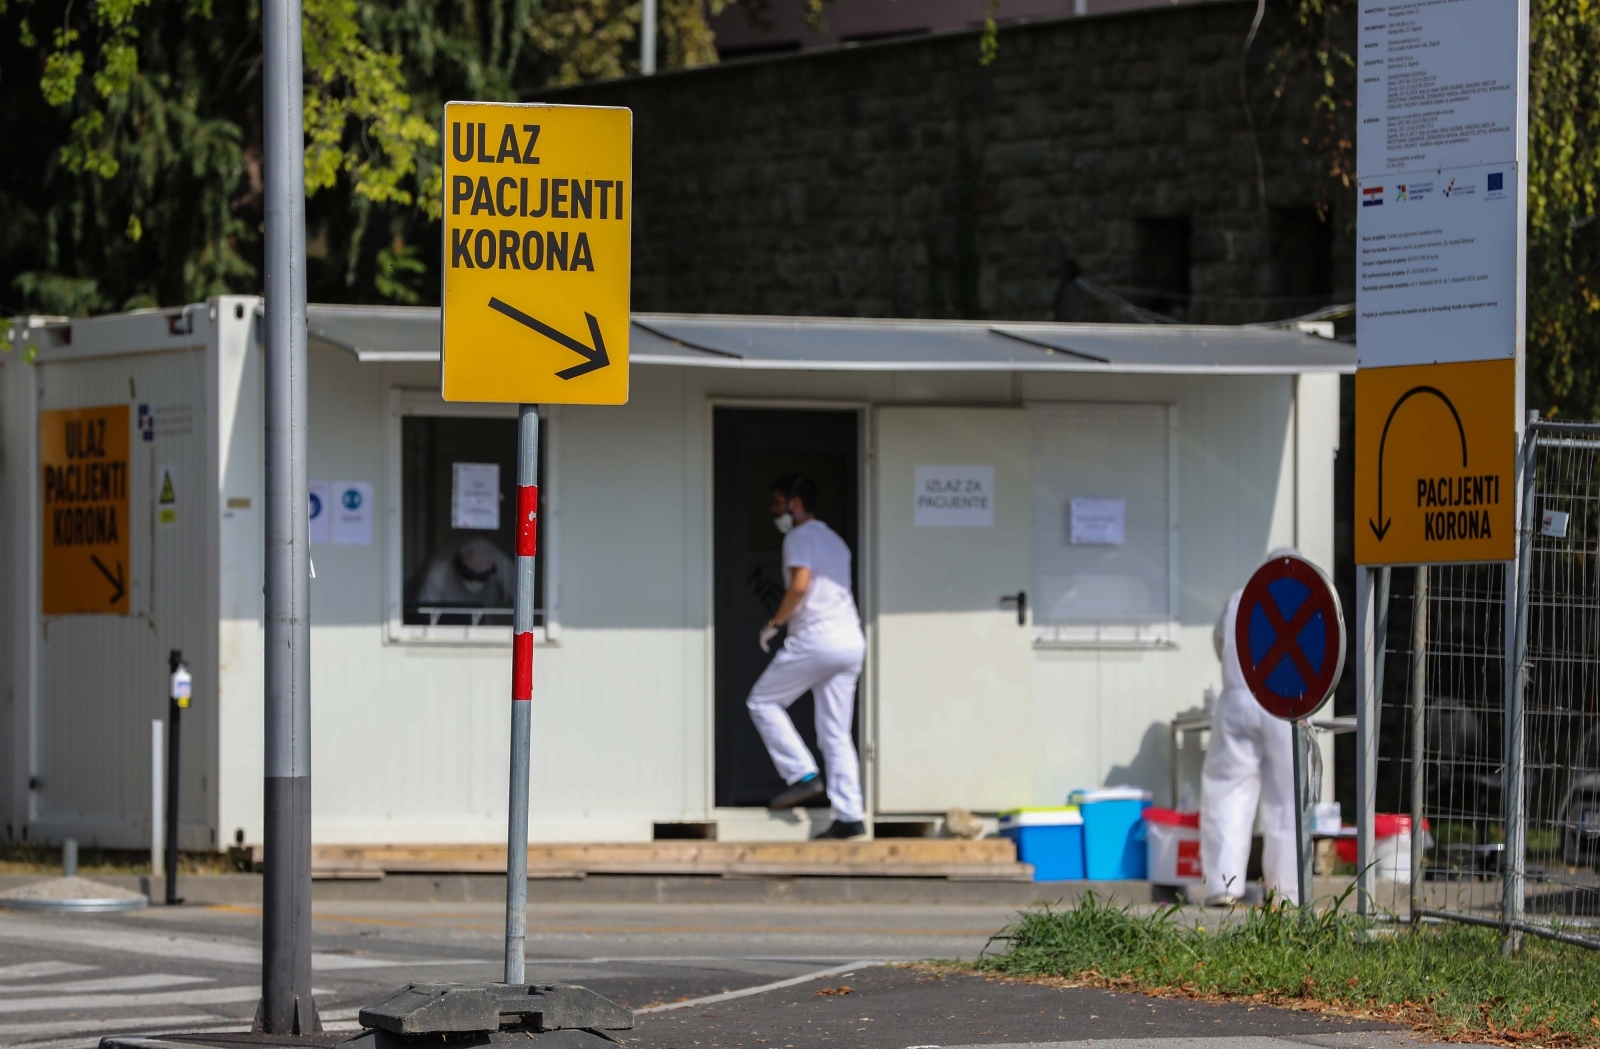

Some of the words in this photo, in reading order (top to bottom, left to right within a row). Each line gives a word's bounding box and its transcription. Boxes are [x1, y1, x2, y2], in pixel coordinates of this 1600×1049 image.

[452, 121, 541, 165] ULAZ
[452, 175, 624, 220] PACIJENTI
[451, 228, 595, 272] KORONA
[65, 417, 107, 460] ULAZ
[45, 462, 126, 503] PACIJENTI
[917, 495, 989, 510] PACIJENTE
[925, 479, 961, 493] IZLAZ
[965, 479, 983, 493] ZA
[1417, 475, 1499, 508] PACIJENTI
[53, 506, 118, 547] KORONA
[1425, 510, 1492, 541] KORONA
